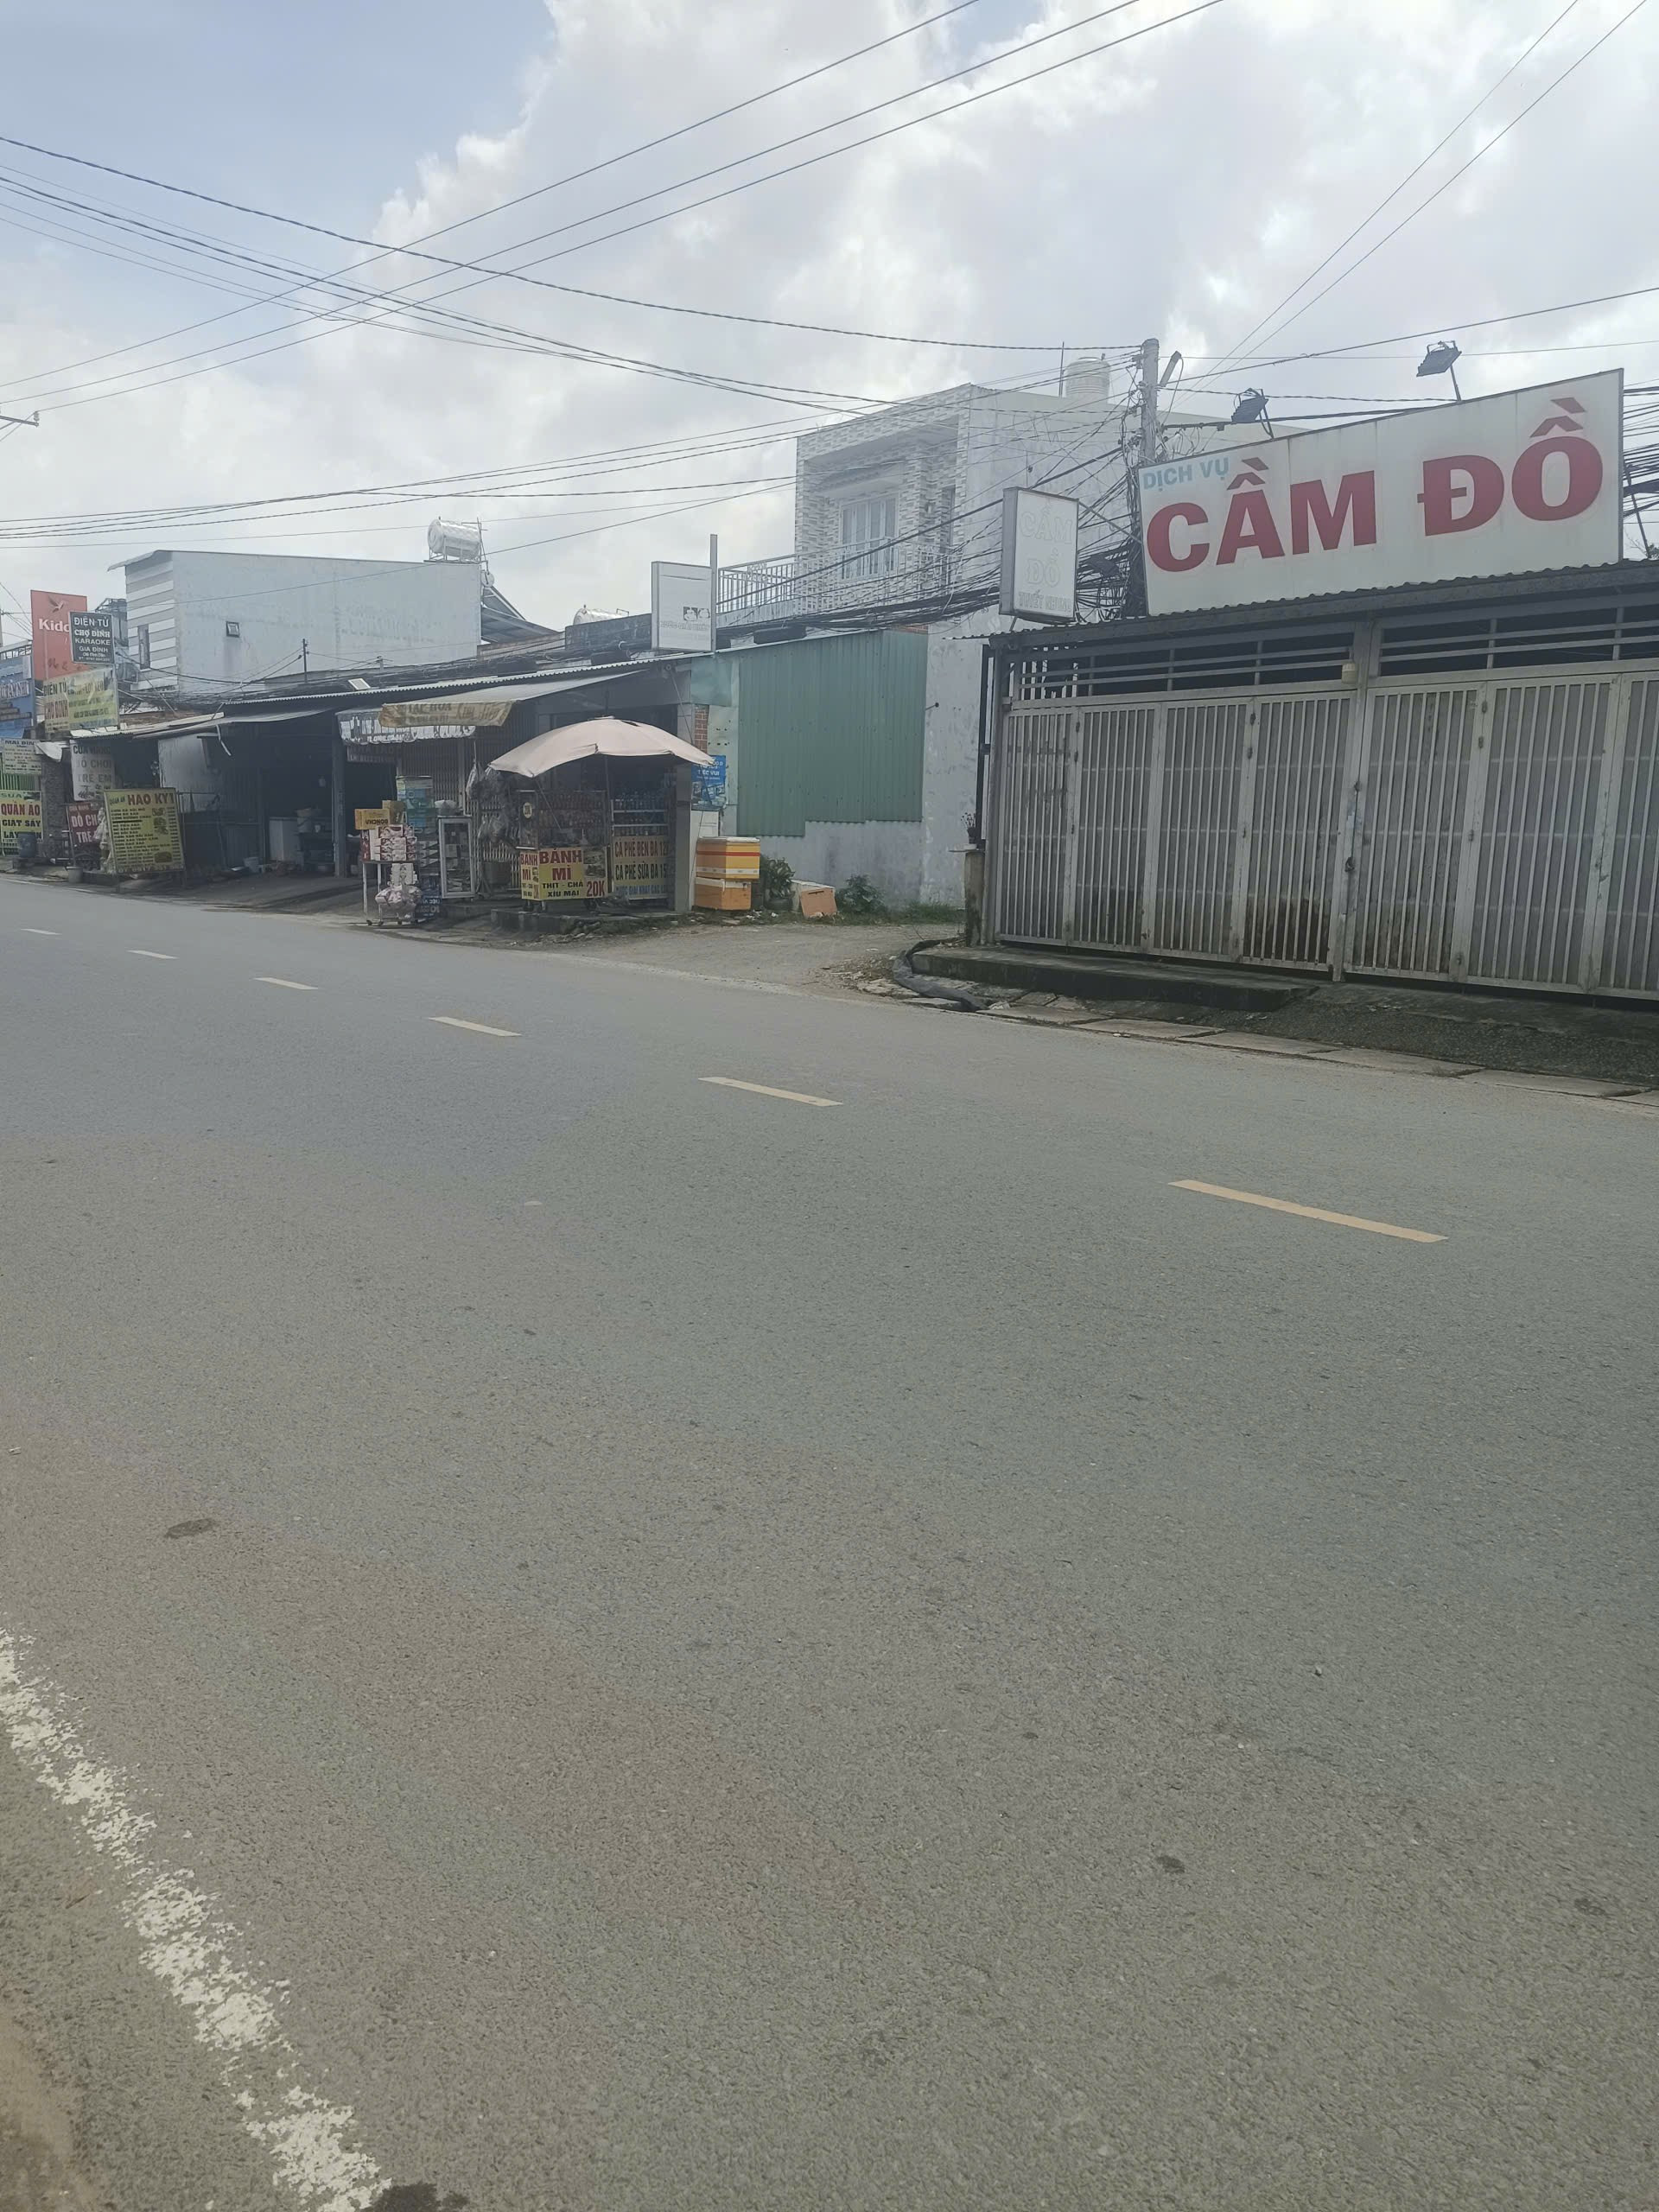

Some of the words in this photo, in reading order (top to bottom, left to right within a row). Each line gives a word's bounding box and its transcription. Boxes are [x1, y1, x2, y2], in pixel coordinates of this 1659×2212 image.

[1143, 461, 1194, 491] DỊCH
[1200, 457, 1230, 482] VỤ
[1147, 457, 1377, 573] CẦM
[1417, 397, 1604, 537] ĐỒ
[74, 638, 111, 646] KARAOKE
[539, 848, 582, 864] BÁNH
[552, 864, 572, 881] MÌ
[586, 880, 606, 897] 20K
